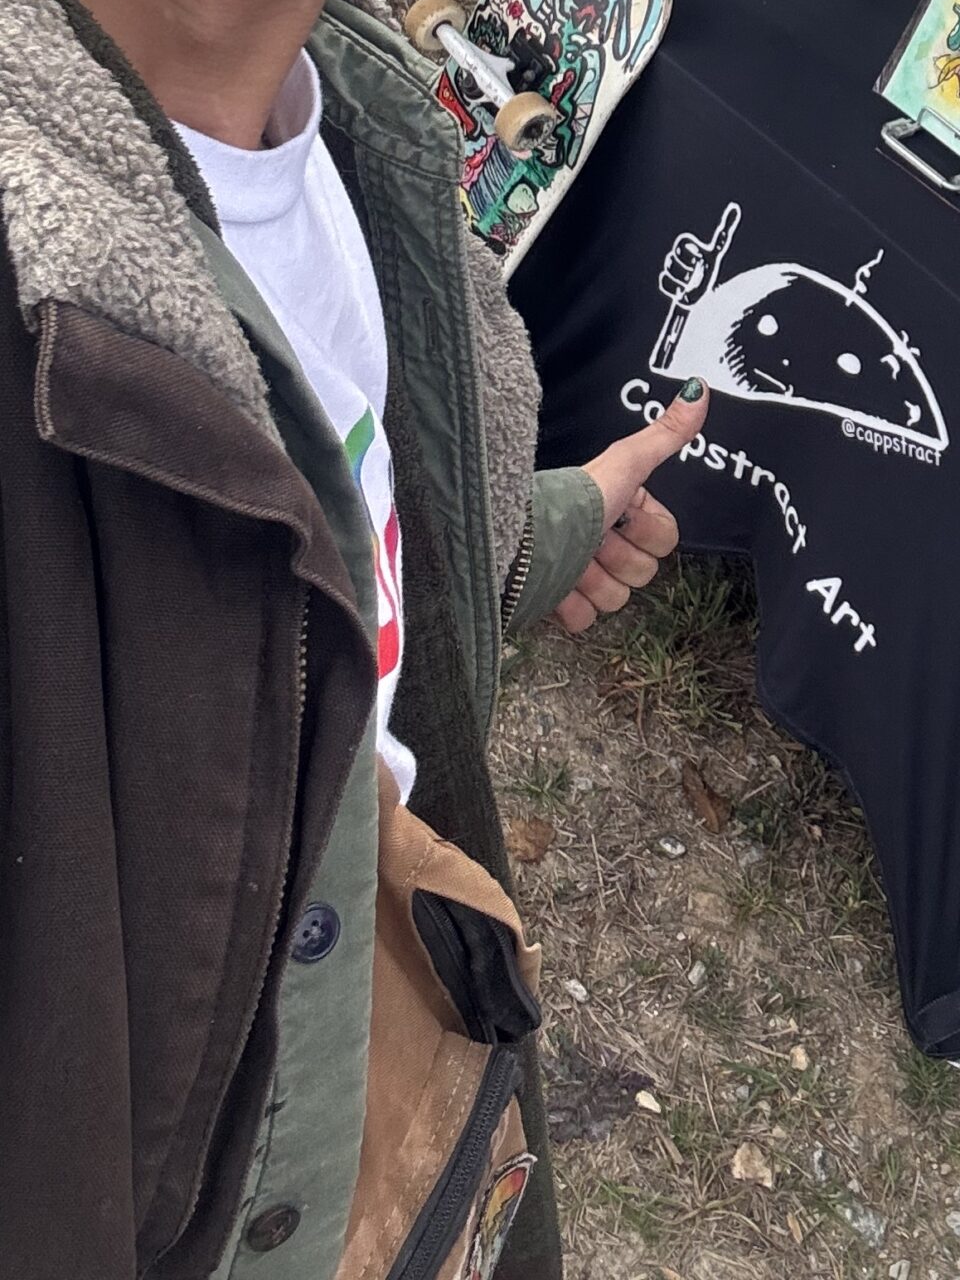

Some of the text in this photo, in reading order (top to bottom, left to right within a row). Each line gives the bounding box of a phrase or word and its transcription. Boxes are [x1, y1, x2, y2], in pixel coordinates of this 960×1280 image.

[620, 377, 877, 652] Capstract Art
[842, 418, 941, 466] @cappstract
